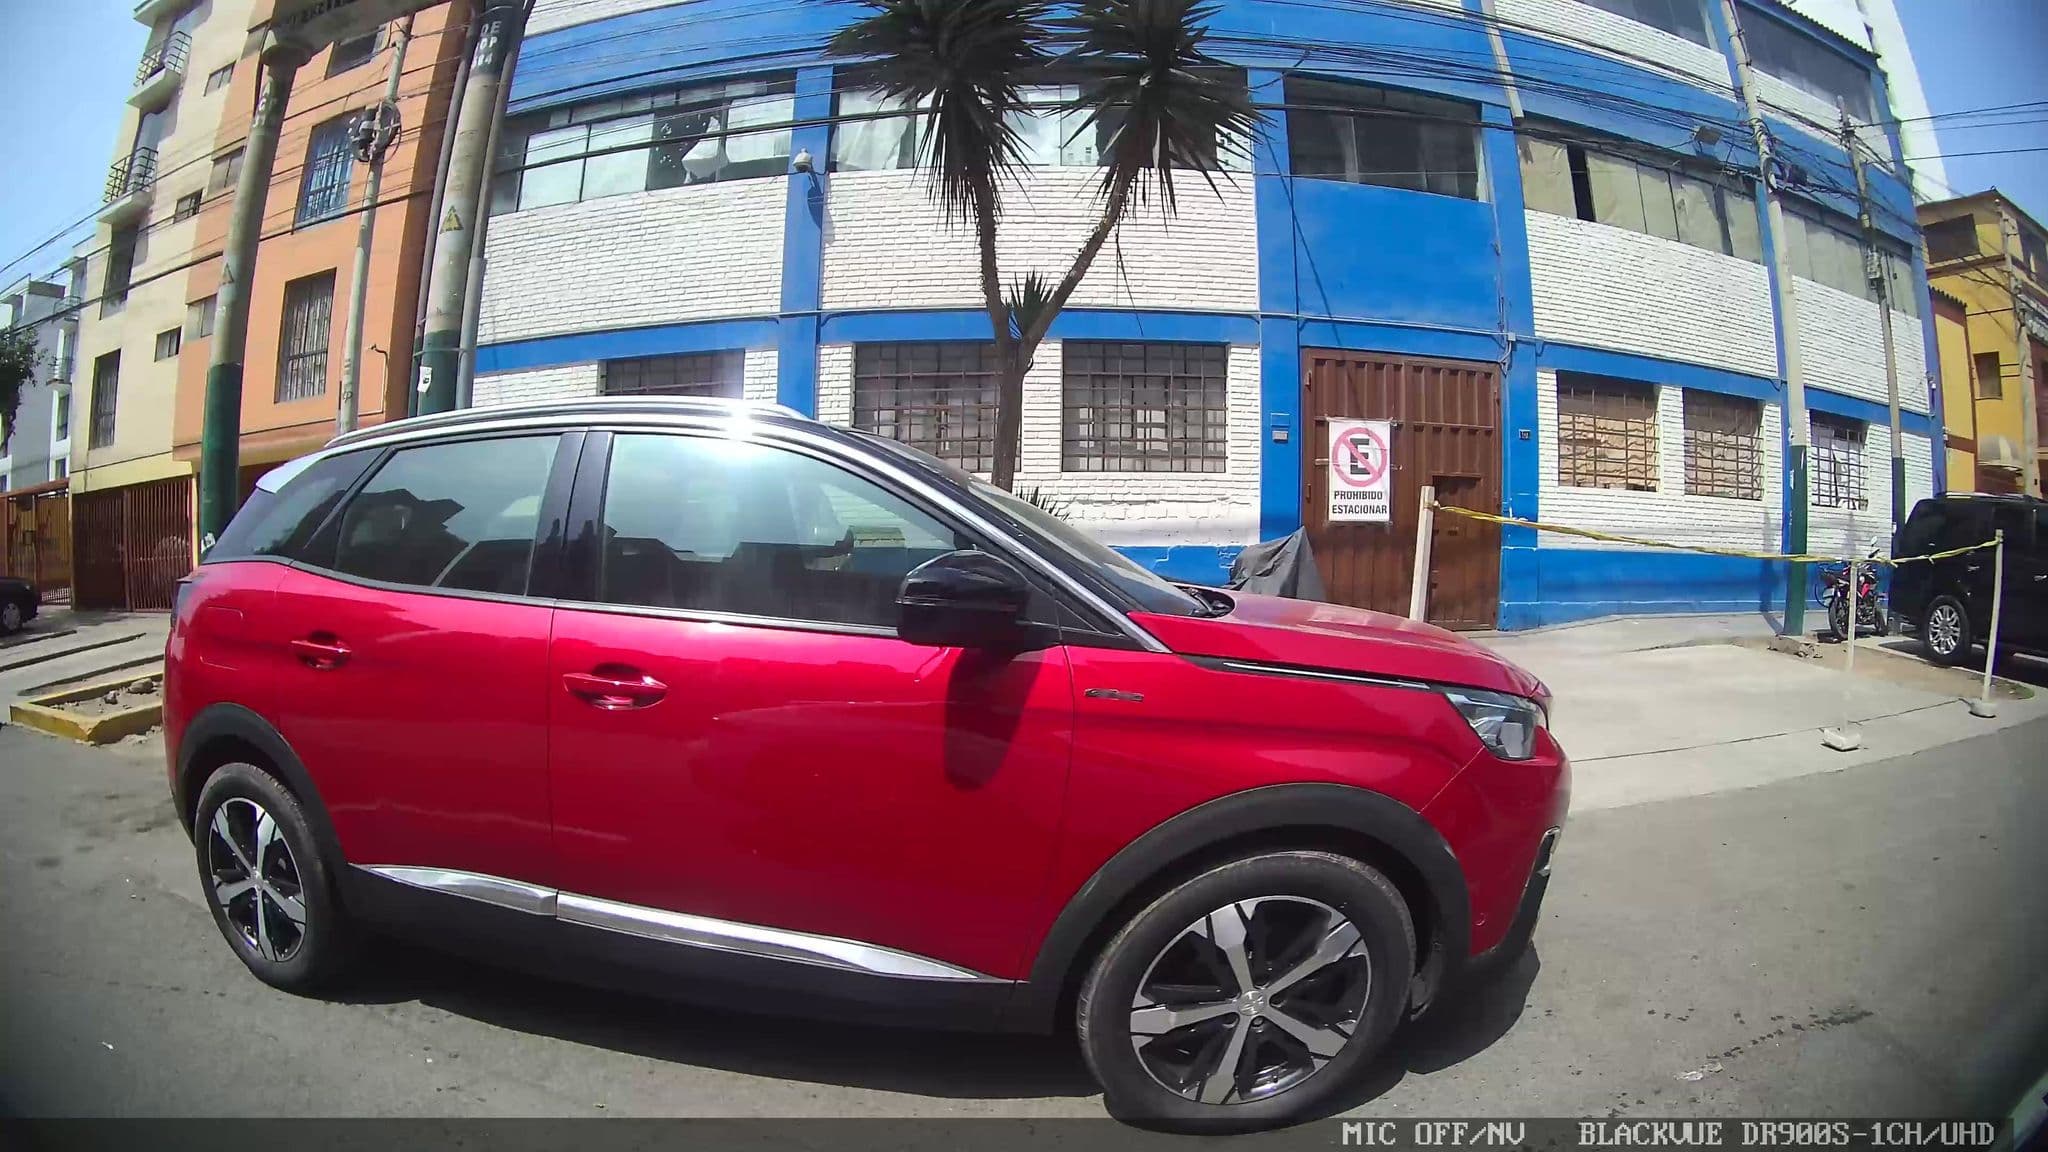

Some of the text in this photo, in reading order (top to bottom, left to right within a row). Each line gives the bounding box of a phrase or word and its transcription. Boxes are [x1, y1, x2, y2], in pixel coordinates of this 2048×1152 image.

[1350, 438, 1371, 475] E
[1334, 490, 1383, 500] PROHIBIDO
[1332, 504, 1387, 514] ESTACIONAR
